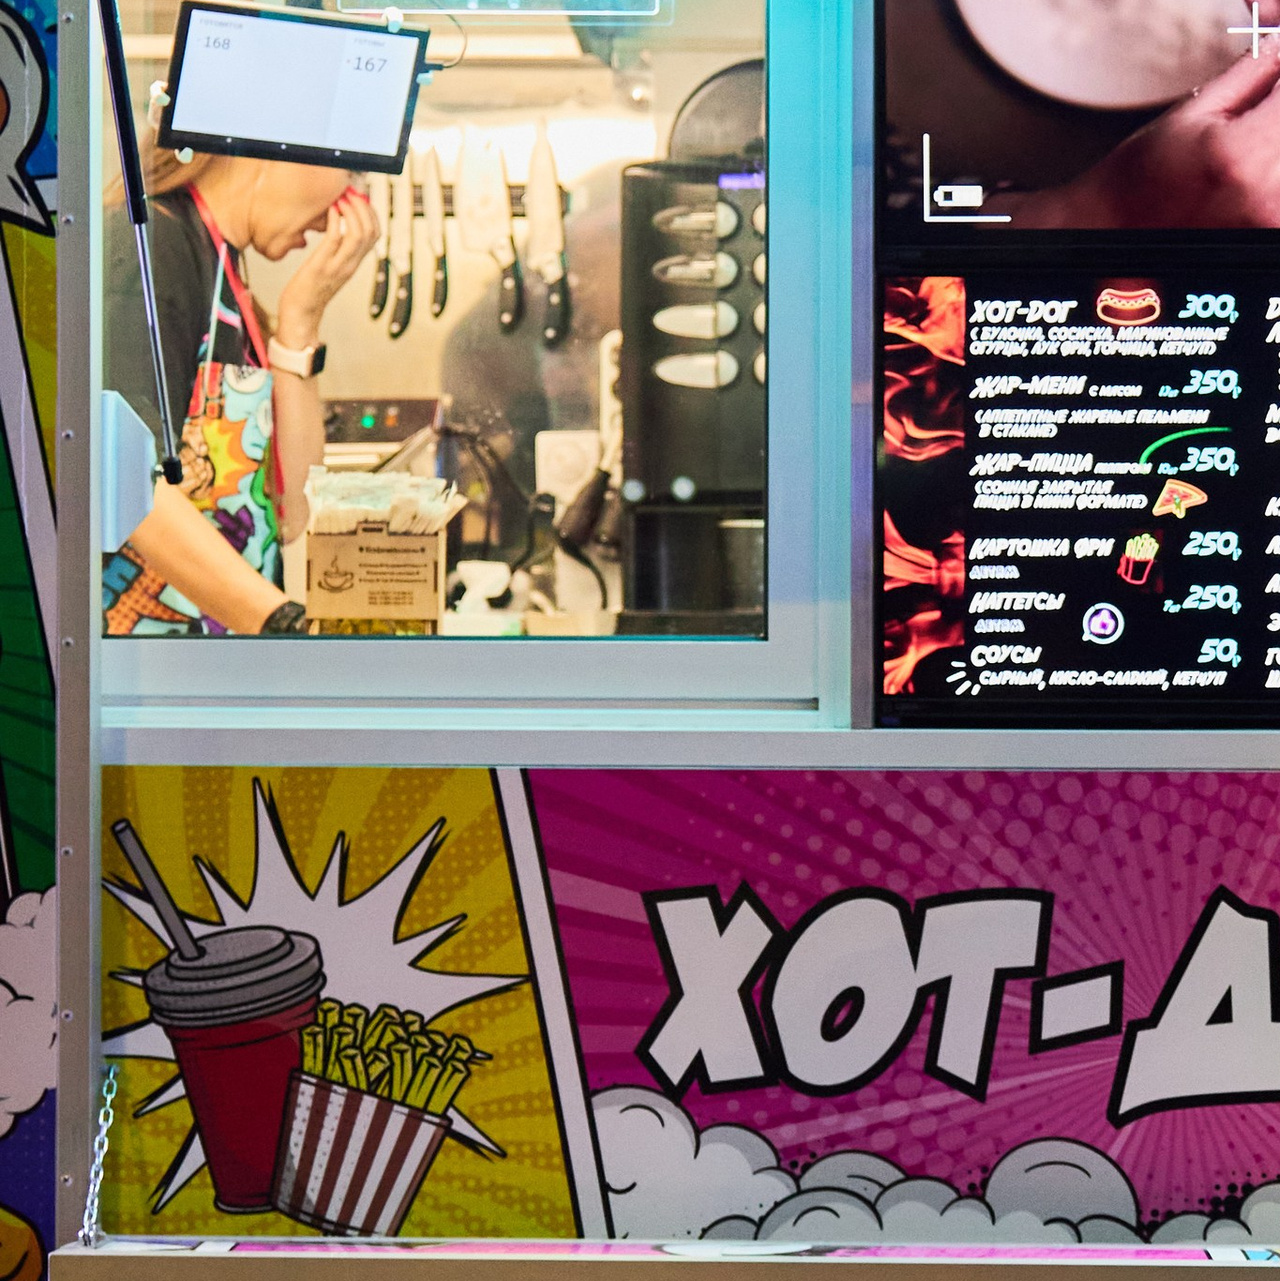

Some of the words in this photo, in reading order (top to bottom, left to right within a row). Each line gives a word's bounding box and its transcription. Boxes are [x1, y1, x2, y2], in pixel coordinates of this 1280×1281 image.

[203, 36, 231, 51] 168
[352, 56, 388, 74] 167
[1030, 342, 1060, 356] ЛУК
[968, 375, 1088, 399] ЖАР-МЕНИ
[1067, 409, 1137, 424] ЖАРЕНЫЕ
[1136, 409, 1210, 424] ПЕЛЬМЕНИ
[978, 424, 992, 438] В
[969, 452, 1094, 477] ЖАР-ПИЦЦА
[1039, 480, 1115, 495] ЗАКРЫТАЯ
[968, 537, 1070, 561] КАРТОШКА
[1073, 537, 1116, 559] ФРИ
[970, 644, 1042, 667] СОУСЫ
[1172, 670, 1228, 687] КЕТЧУП
